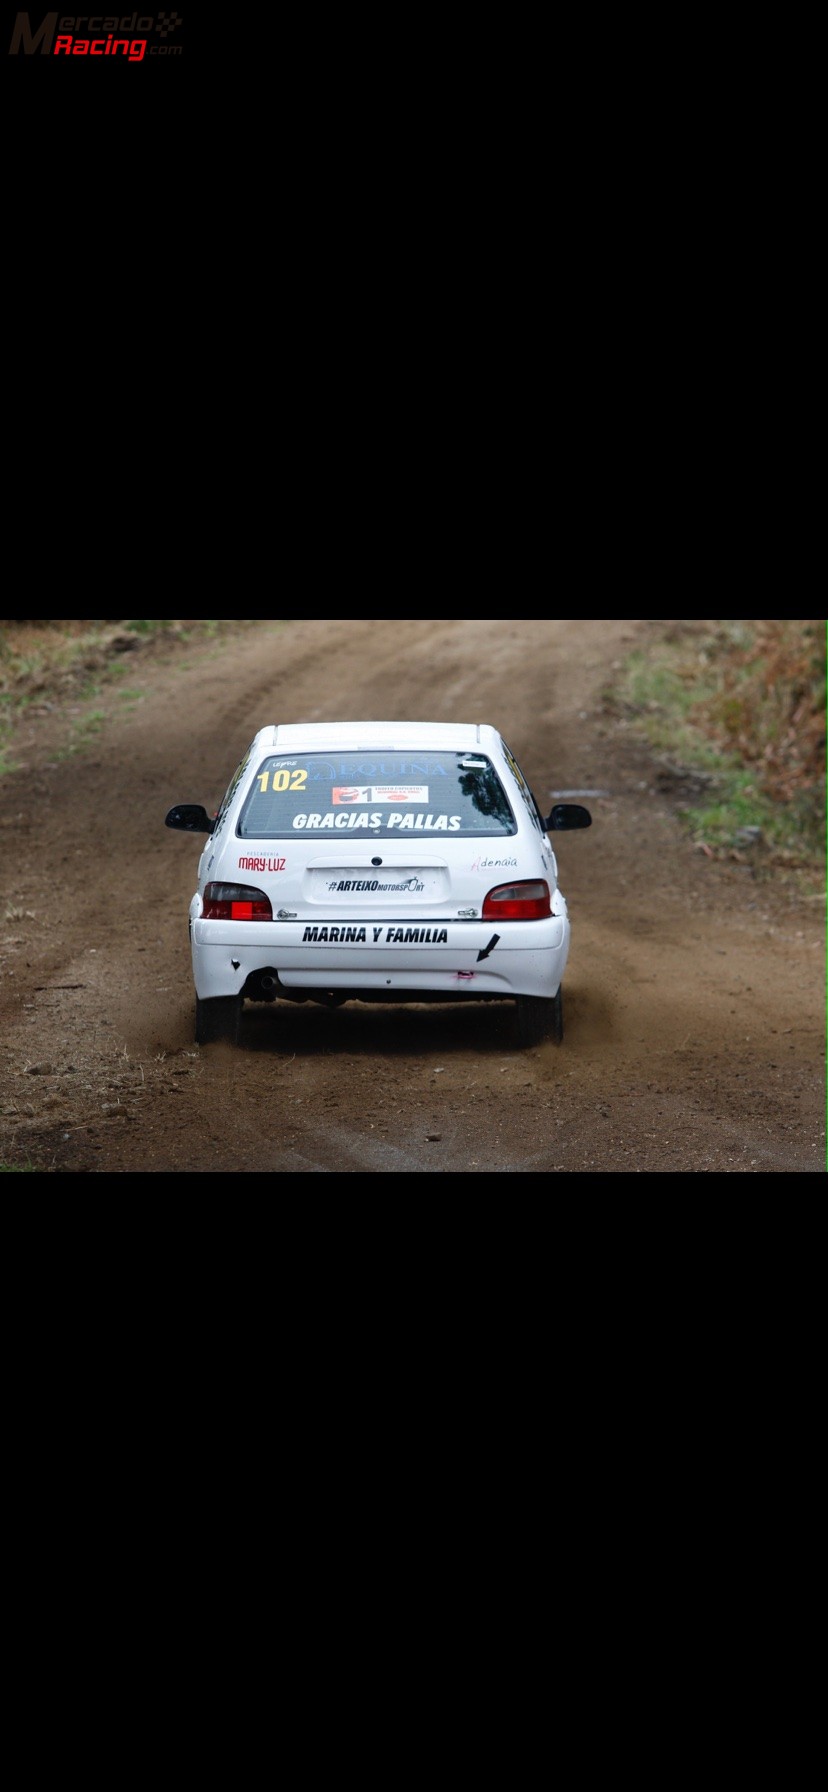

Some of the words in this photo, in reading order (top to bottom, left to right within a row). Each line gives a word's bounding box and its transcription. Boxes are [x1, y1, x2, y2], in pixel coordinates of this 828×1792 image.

[257, 769, 308, 792] 102
[362, 788, 372, 802] 1
[292, 813, 382, 829] GRACIAS
[386, 813, 462, 831] PALLAS
[302, 927, 367, 942] MARINA
[372, 927, 383, 943] Y
[386, 928, 448, 943] FAMILIA
